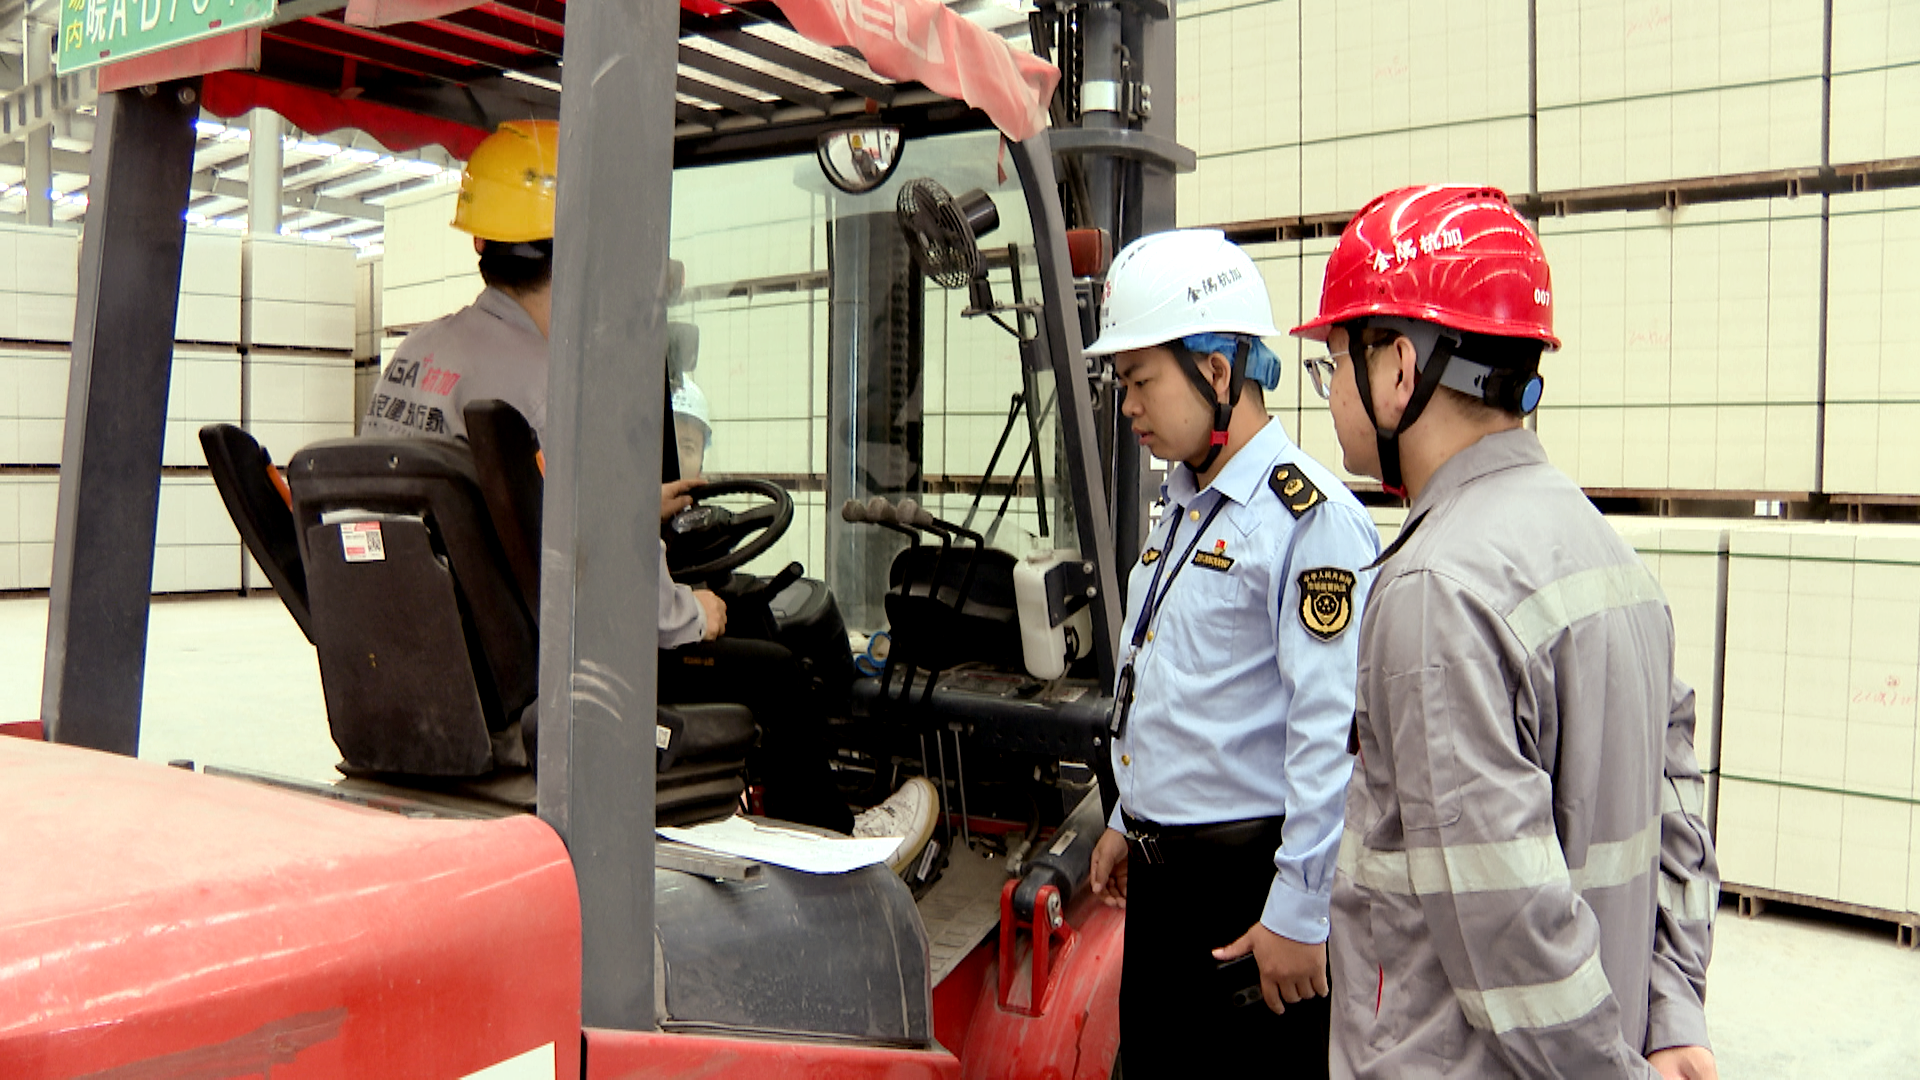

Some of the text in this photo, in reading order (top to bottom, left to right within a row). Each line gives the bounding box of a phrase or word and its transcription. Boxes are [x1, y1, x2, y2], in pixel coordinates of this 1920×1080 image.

[1373, 227, 1463, 274] 金隅杭加
[1187, 267, 1242, 303] 金隅杭加
[1534, 288, 1551, 307] 007
